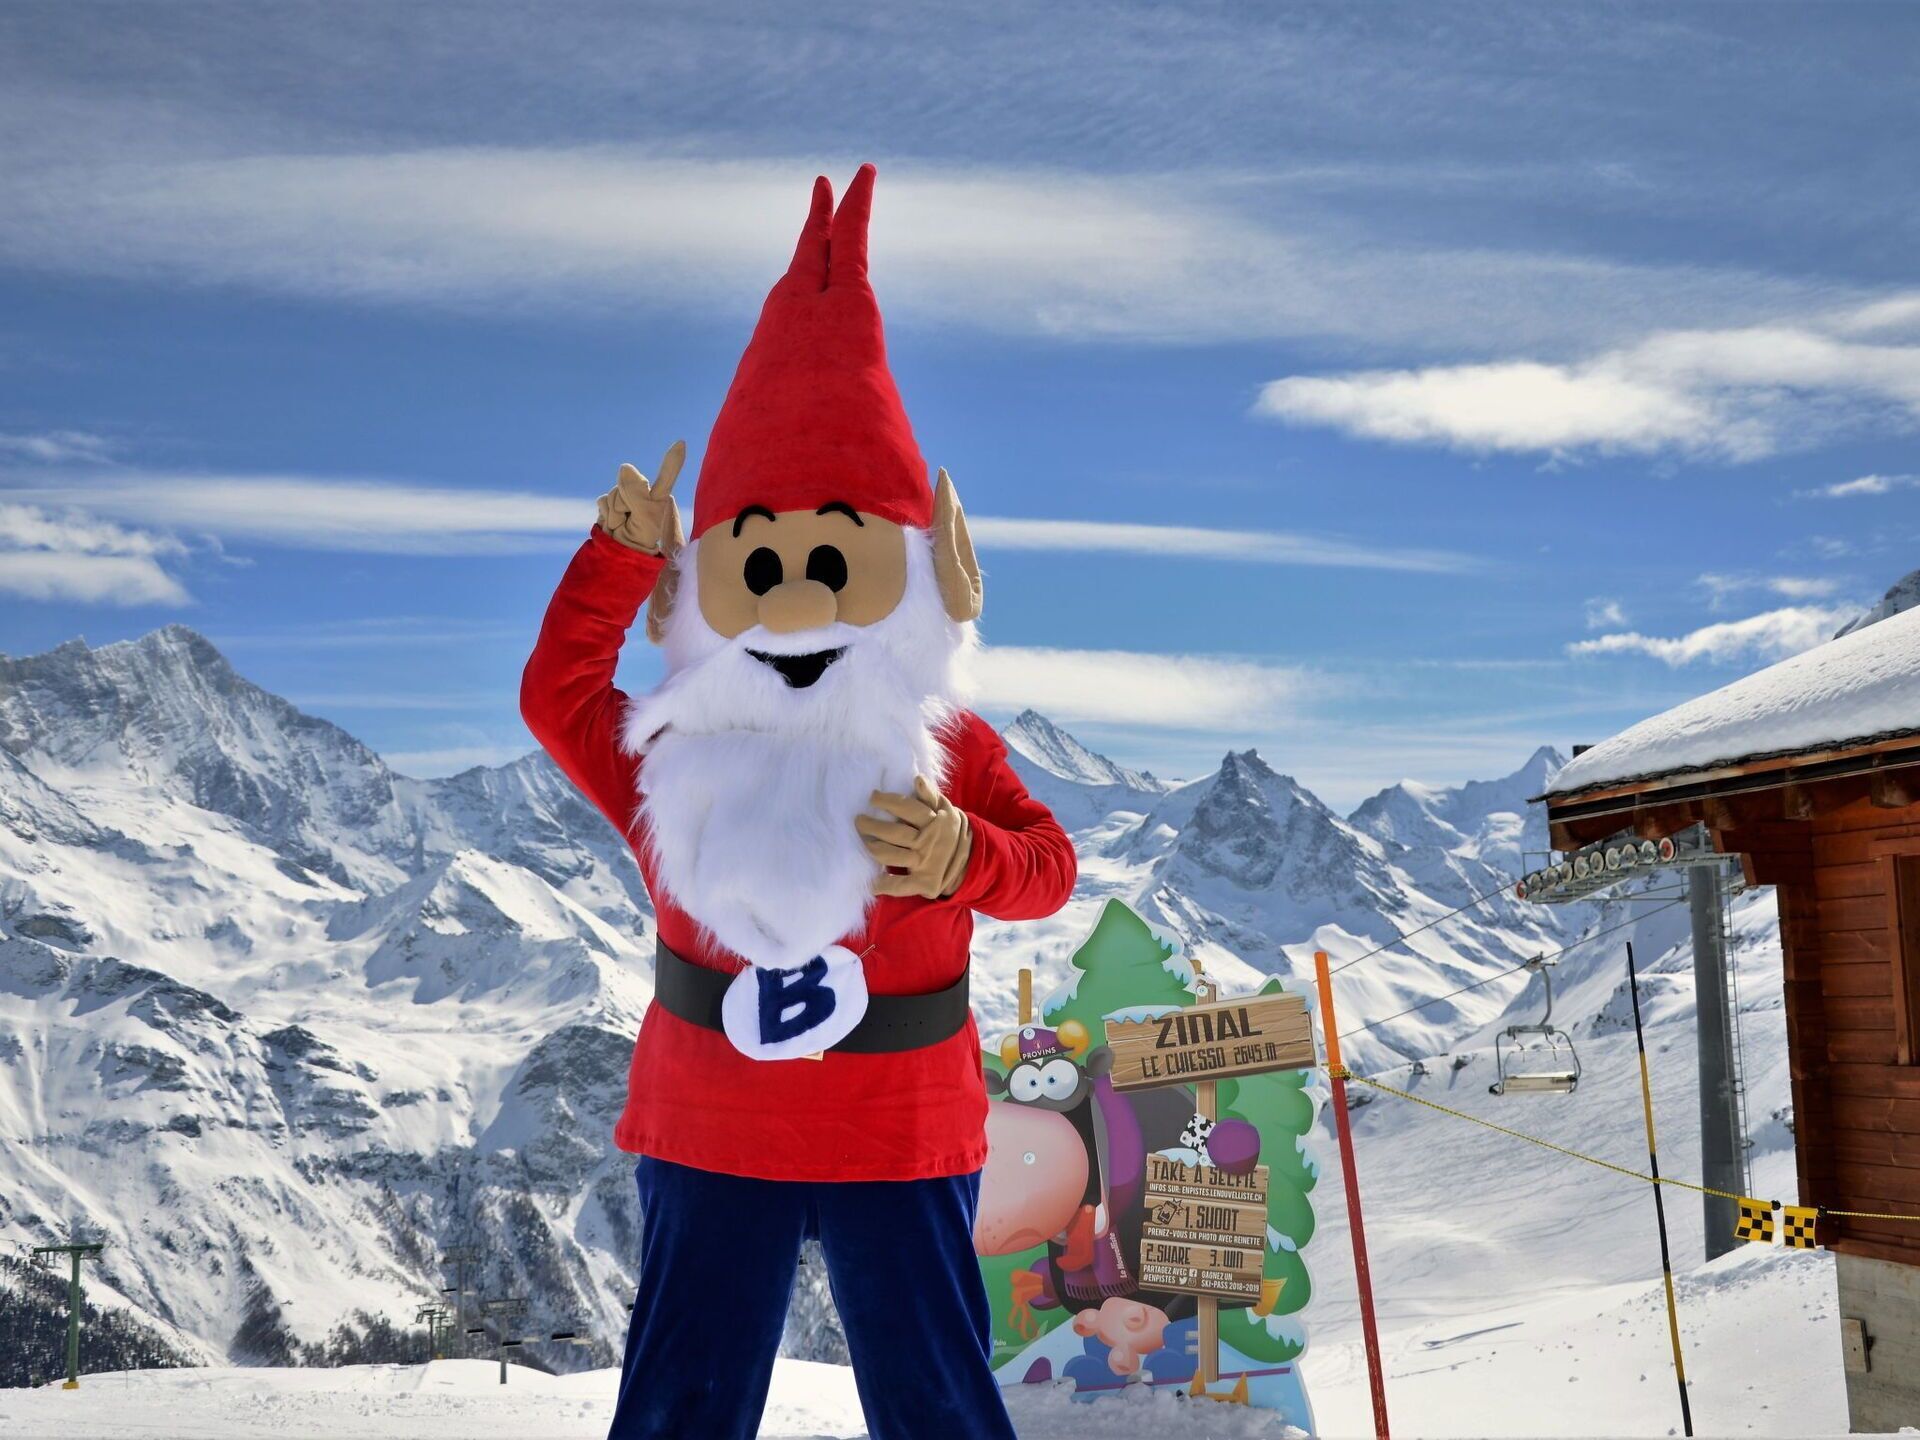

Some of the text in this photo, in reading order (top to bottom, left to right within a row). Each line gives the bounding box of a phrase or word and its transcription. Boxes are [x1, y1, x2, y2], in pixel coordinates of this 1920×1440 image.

[756, 955, 836, 1044] B
[1152, 1008, 1262, 1048] ZINAL
[1023, 1047, 1056, 1059] PROVINS
[1142, 1055, 1159, 1078] LE
[1234, 1044, 1262, 1065] 2645
[1265, 1042, 1276, 1060] M
[1153, 1161, 1186, 1181] TAKE
[1194, 1165, 1202, 1184] A
[1149, 1184, 1262, 1201] INFOS SUR: ENPISTES.LENOUVELLISTE.CH
[1185, 1206, 1239, 1231] 1. SHOOT
[1148, 1228, 1188, 1239] PRENEZ-VOUS
[1198, 1233, 1217, 1241] PHOTO
[1219, 1235, 1232, 1243] AVEC
[1234, 1237, 1260, 1245] REINETTE
[1210, 1250, 1243, 1269] 3. WIN
[1120, 1269, 1127, 1278] Le
[1143, 1273, 1176, 1283] #ENPISTES
[1144, 1266, 1171, 1274] PARTAGEZ
[1201, 1270, 1224, 1279] GAGNEZ
[1201, 1280, 1259, 1292] SKI-PASS 2018-2019
